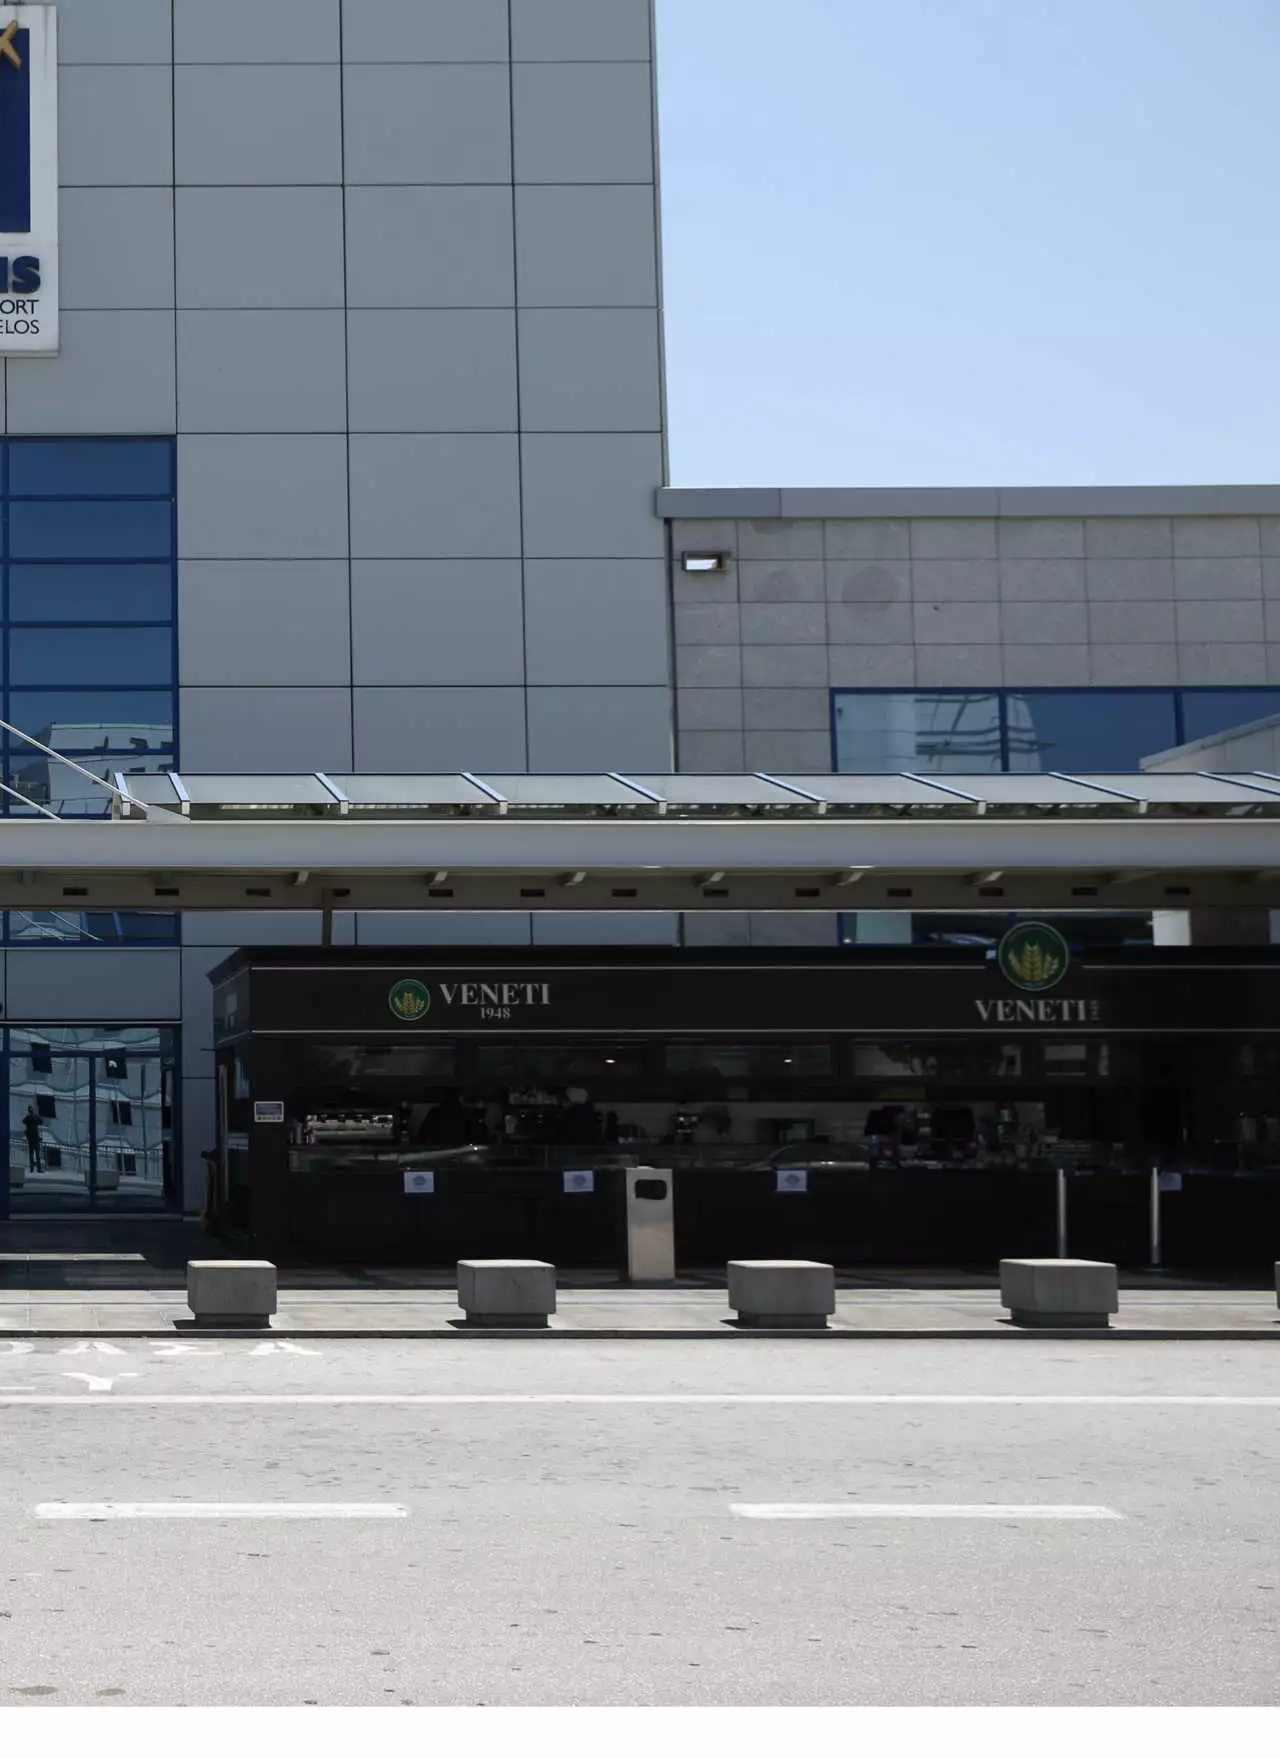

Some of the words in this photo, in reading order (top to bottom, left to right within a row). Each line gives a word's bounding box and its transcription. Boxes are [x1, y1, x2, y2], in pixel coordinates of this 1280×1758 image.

[438, 983, 552, 1005] VENETI
[480, 1007, 511, 1019] 1948
[974, 999, 1087, 1022] VENETI
